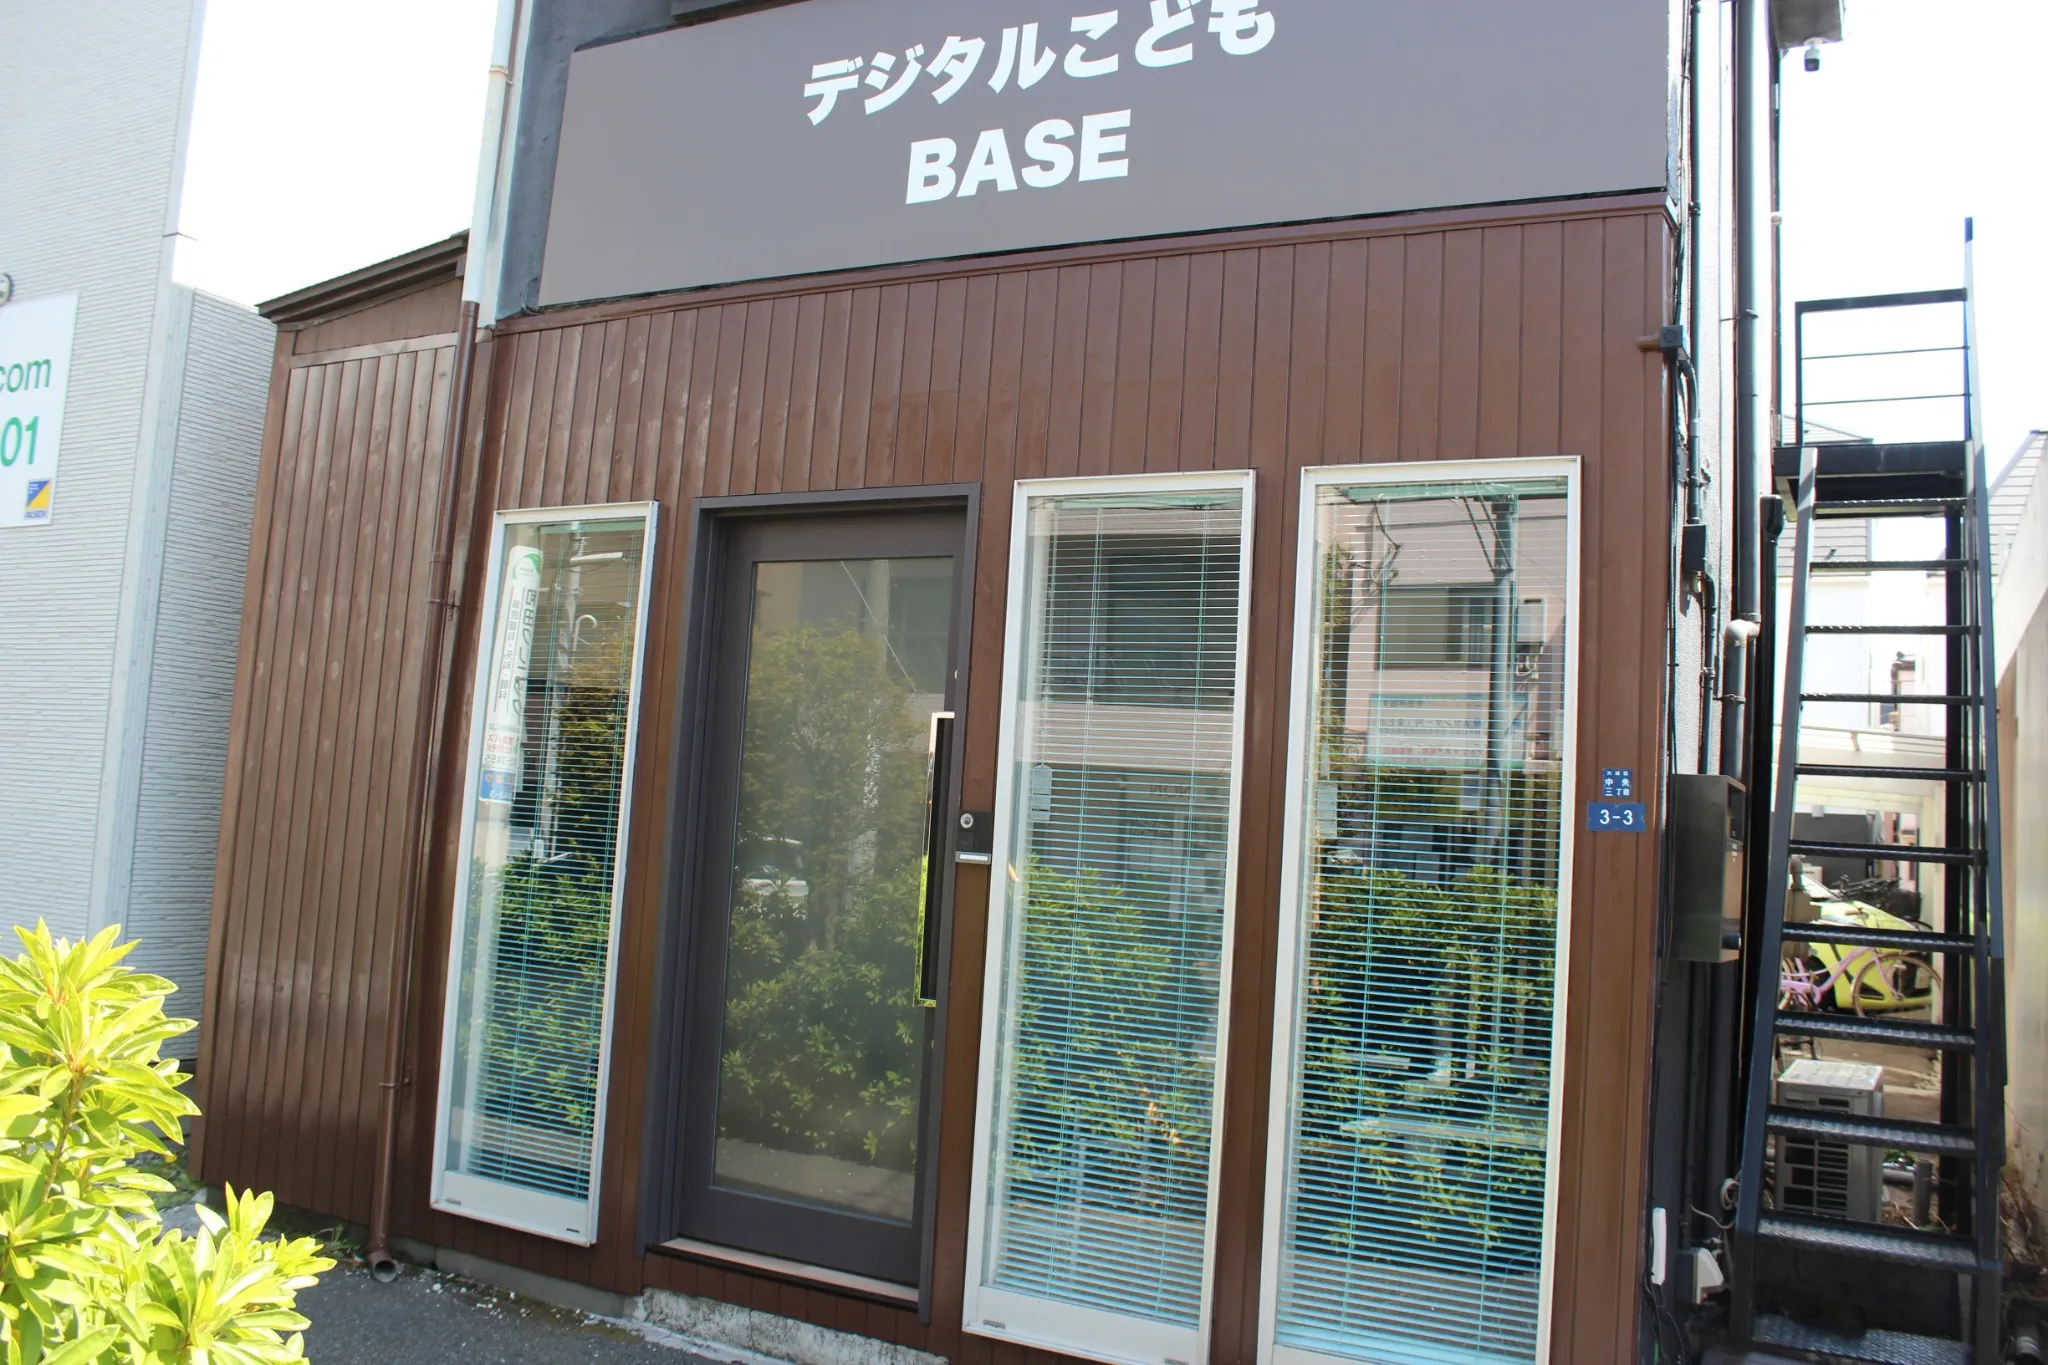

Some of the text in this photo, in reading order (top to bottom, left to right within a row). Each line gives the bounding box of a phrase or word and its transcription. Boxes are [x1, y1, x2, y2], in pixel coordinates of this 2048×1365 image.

[803, 0, 1275, 126] デジタルこども
[905, 109, 1131, 204] BASE
[1605, 777, 1630, 787] 中央
[1605, 787, 1630, 797] 三丁目
[1599, 809, 1633, 825] 3-3
